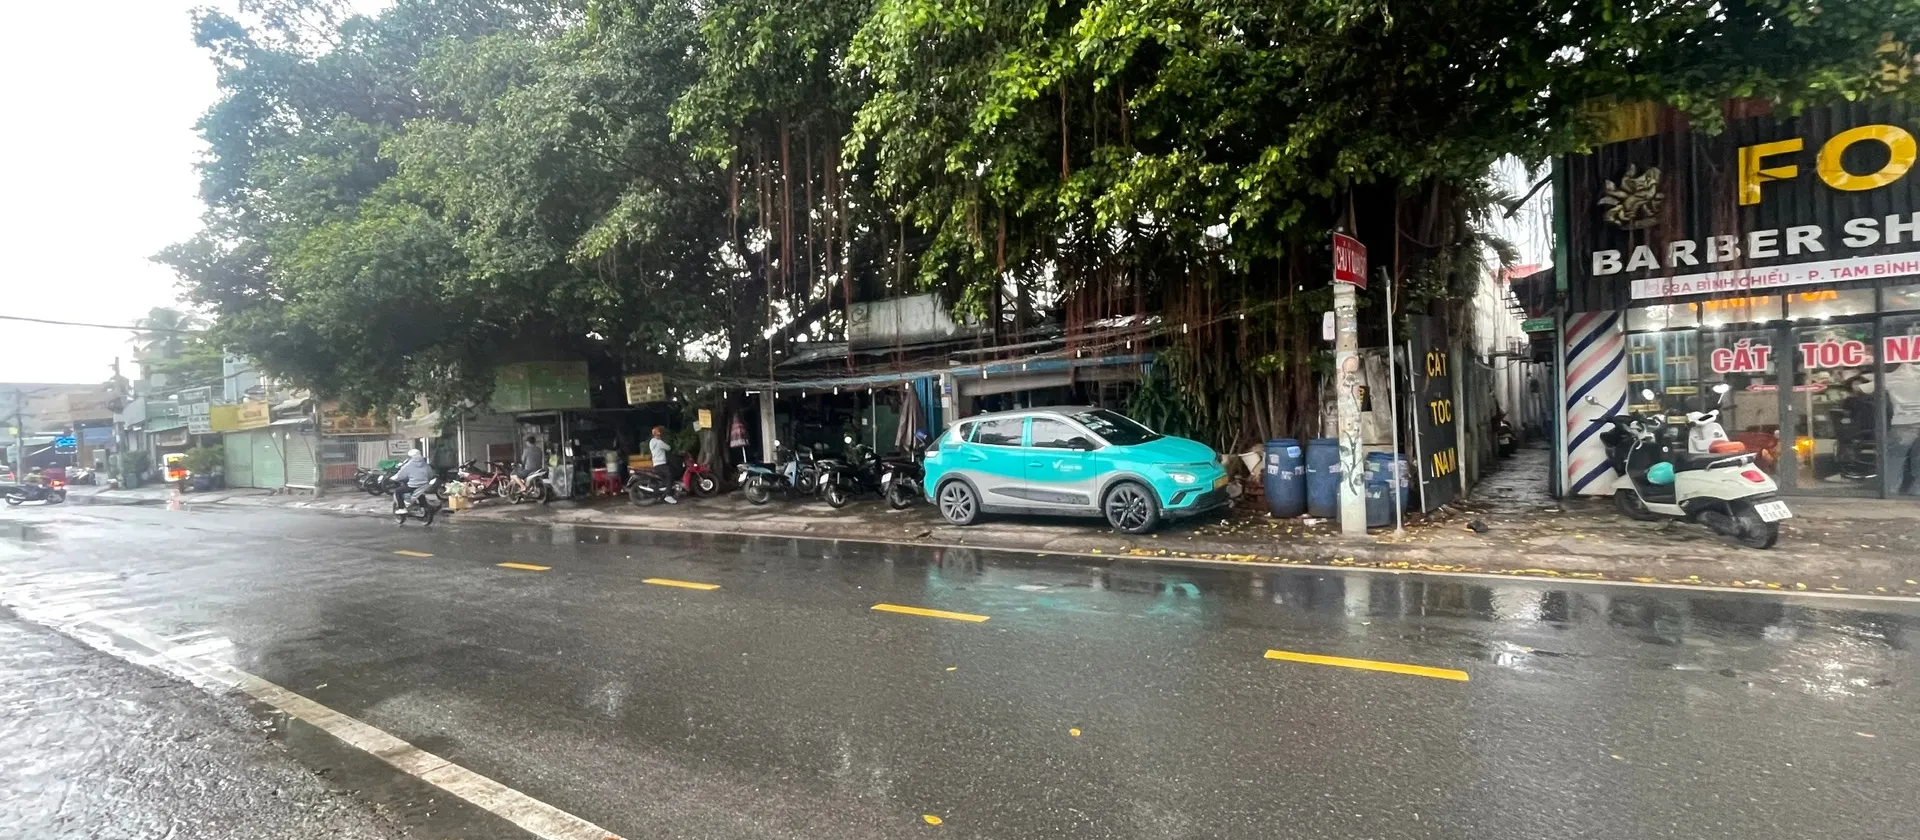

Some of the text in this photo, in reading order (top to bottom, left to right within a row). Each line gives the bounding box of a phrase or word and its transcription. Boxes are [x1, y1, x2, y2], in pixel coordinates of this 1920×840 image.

[1738, 124, 1917, 206] FO
[1592, 211, 1920, 277] BARBER SH
[1696, 275, 1734, 291] BÌNH
[1830, 265, 1868, 278] TAM
[1874, 261, 1920, 275] BÌNH
[1712, 339, 1771, 373] CẮT
[1800, 339, 1864, 368] TÓC
[1433, 447, 1456, 478] NAM
